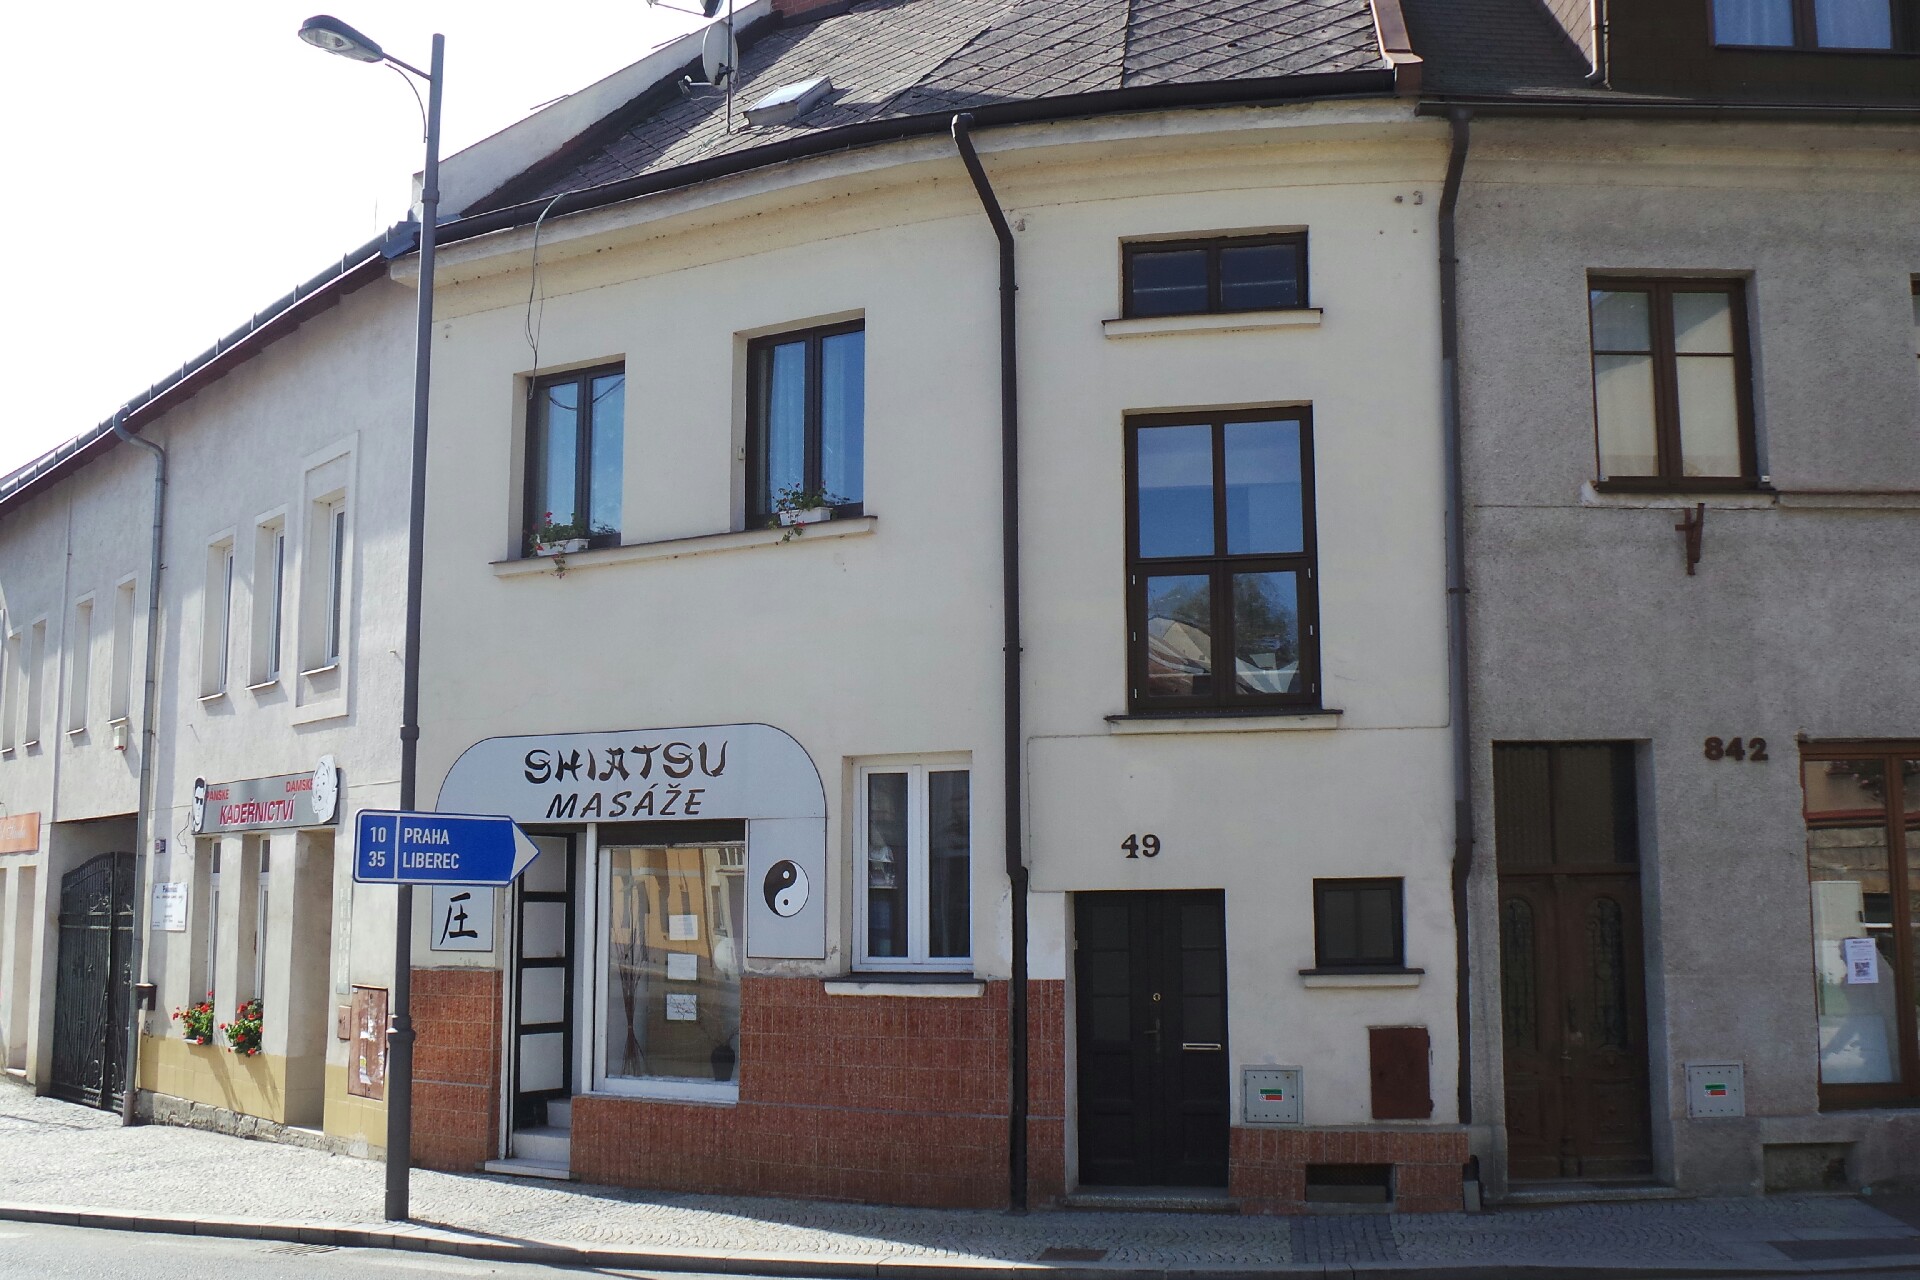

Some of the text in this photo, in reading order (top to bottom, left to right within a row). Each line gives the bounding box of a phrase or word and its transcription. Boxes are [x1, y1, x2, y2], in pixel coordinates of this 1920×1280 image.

[1704, 736, 1769, 762] 842
[524, 740, 728, 785] SHIATSU
[219, 793, 296, 826] KADEŘNICTVÍ
[545, 782, 706, 819] MASÁŽE
[370, 826, 450, 845] 10 PRAHA
[1121, 834, 1161, 859] 49
[368, 851, 460, 869] 35 LIBEREC
